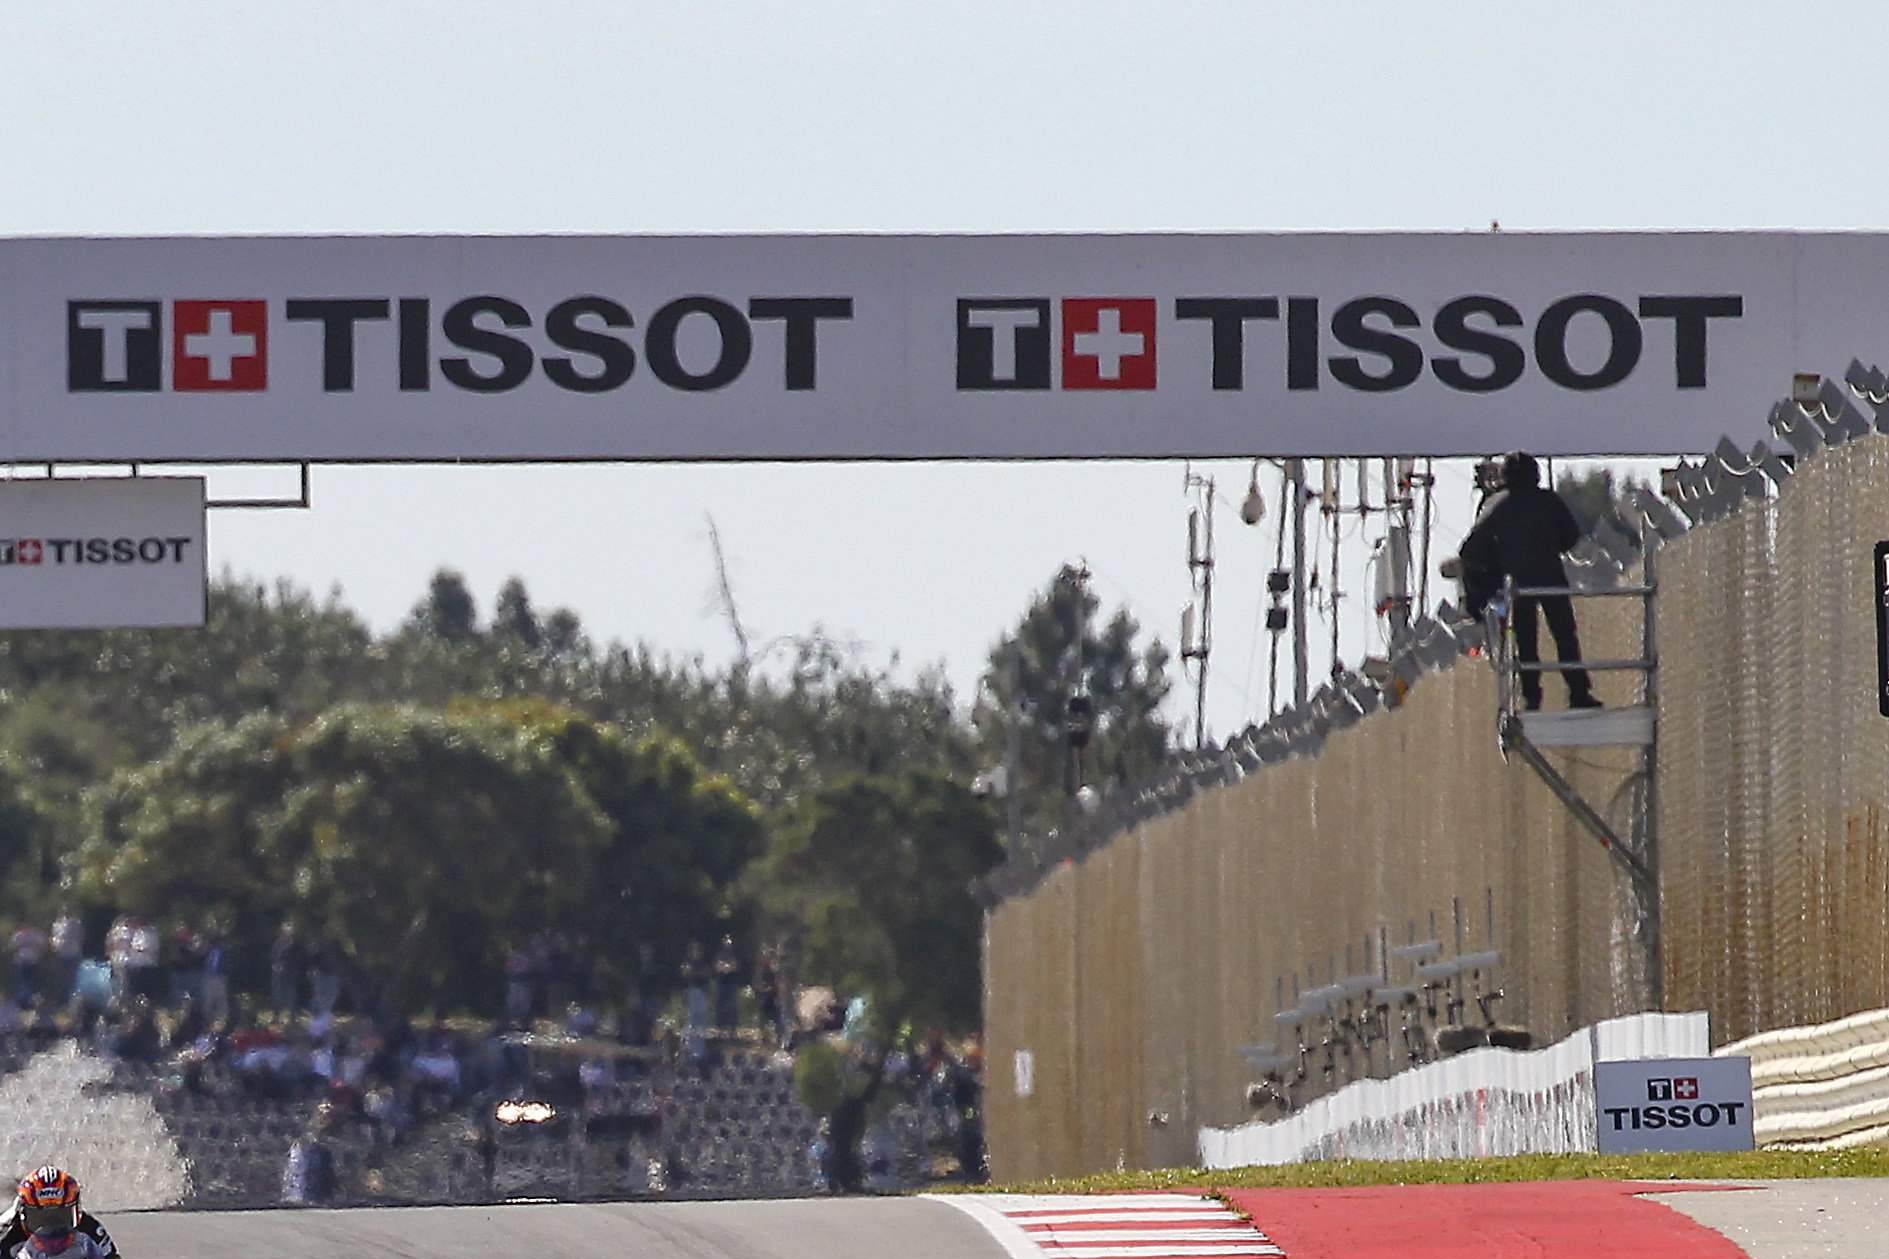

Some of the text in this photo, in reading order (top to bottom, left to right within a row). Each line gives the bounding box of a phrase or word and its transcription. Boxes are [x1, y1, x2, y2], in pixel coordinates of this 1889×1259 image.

[286, 295, 853, 393] TISSOT
[1175, 294, 1743, 393] TISSOT
[47, 537, 192, 564] TISSOT
[1604, 1102, 1744, 1130] TISSOT
